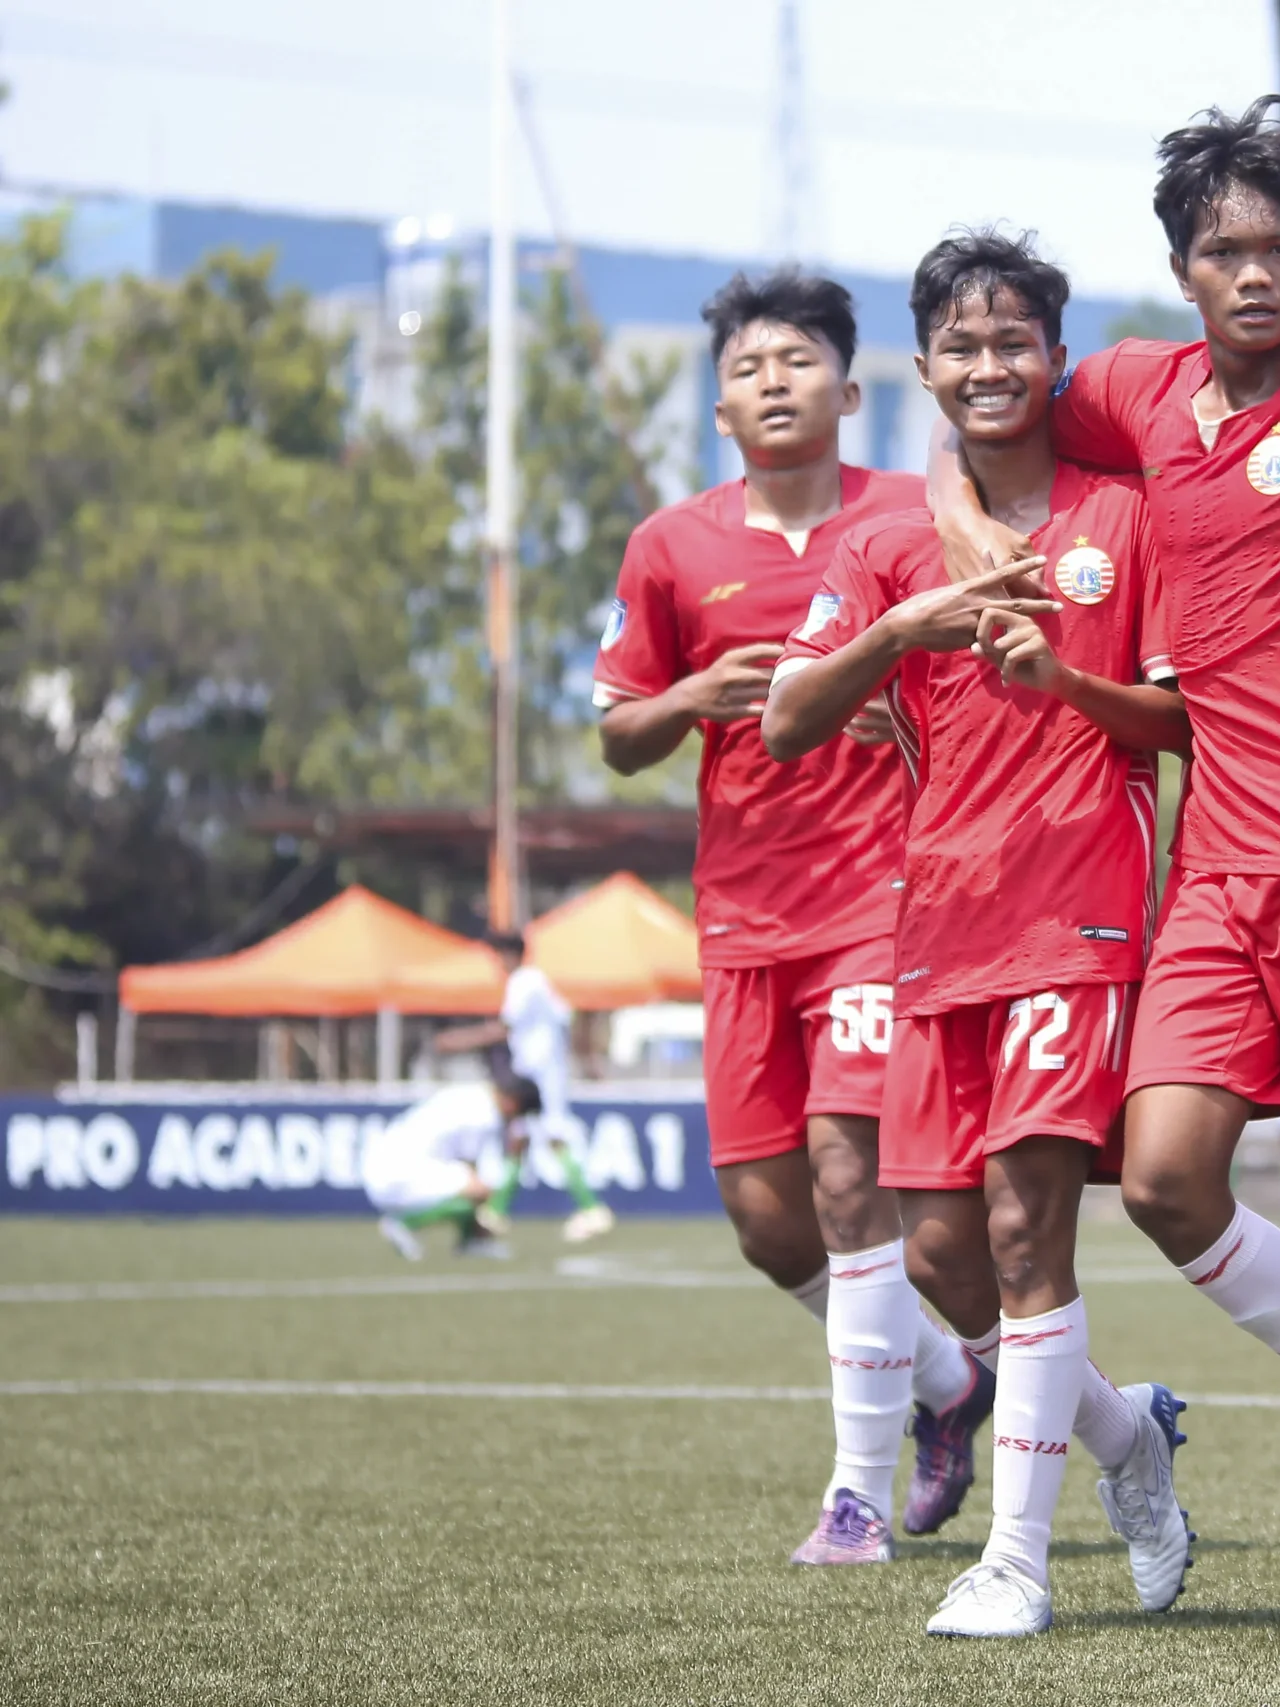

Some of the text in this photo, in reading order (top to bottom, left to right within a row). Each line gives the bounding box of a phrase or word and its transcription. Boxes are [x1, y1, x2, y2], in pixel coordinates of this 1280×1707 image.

[1003, 992, 1069, 1070] 72
[6, 1112, 140, 1191] PRO
[147, 1112, 390, 1191] ACADE
